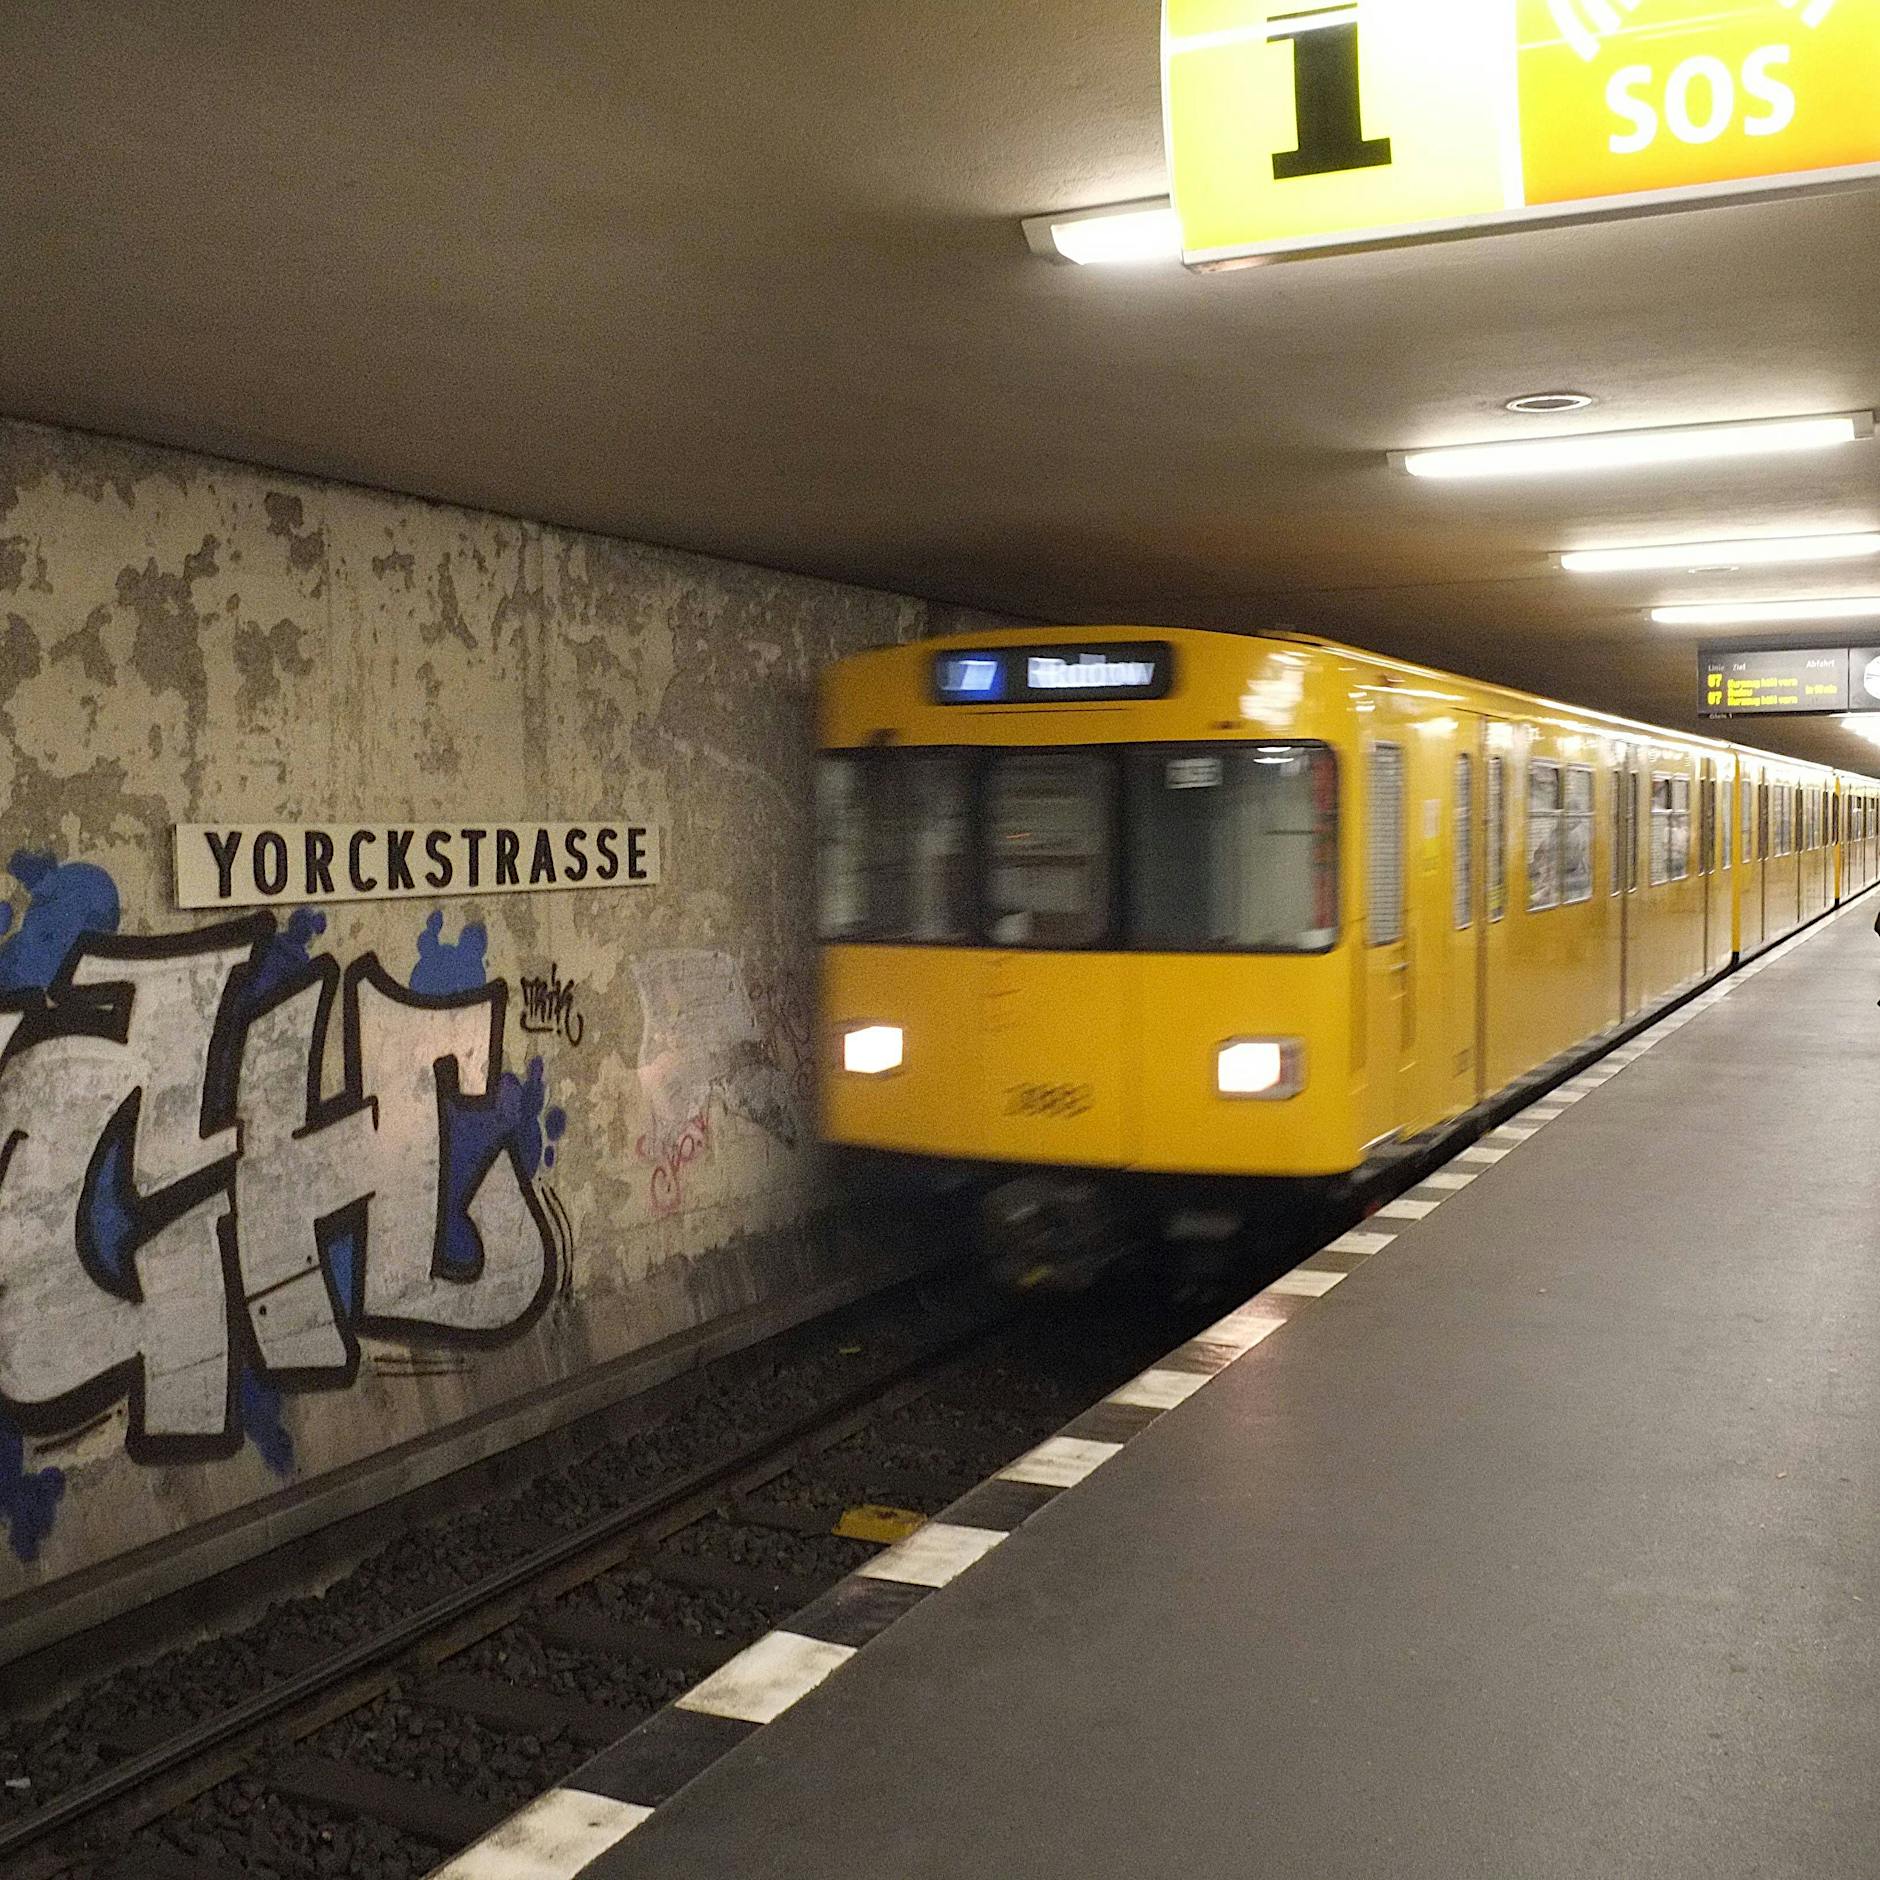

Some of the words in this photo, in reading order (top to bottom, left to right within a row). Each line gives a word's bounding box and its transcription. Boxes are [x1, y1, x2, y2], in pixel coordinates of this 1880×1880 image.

[1605, 43, 1797, 155] SOS
[1806, 660, 1835, 668] Abfahrt
[204, 828, 647, 898] YORCKSTRASSE
